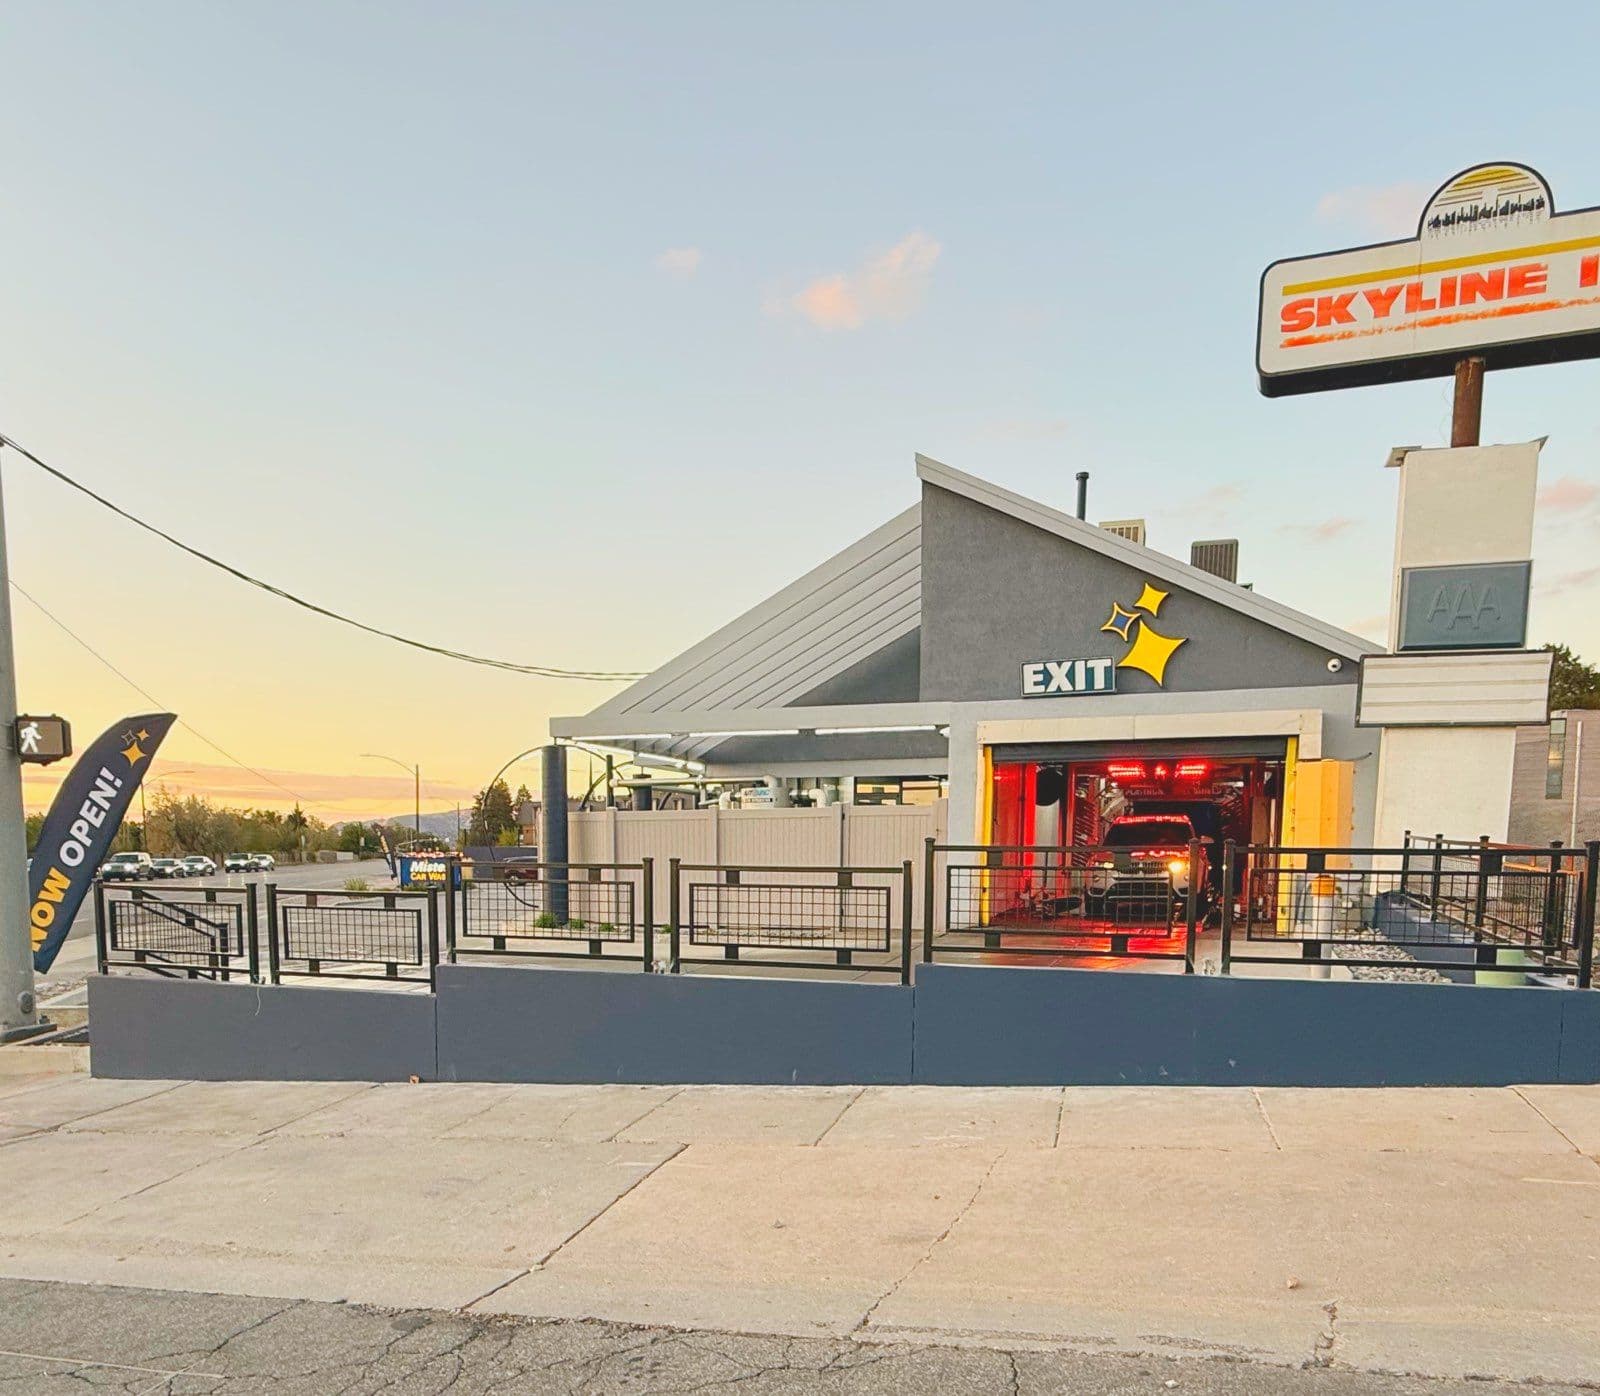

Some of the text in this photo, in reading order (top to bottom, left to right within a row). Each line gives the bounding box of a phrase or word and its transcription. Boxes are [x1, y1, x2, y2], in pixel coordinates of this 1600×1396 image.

[1281, 263, 1548, 333] SKYLINE
[1427, 583, 1502, 630] AAA
[1023, 659, 1112, 694] EXIT
[59, 766, 123, 867] OPEN!
